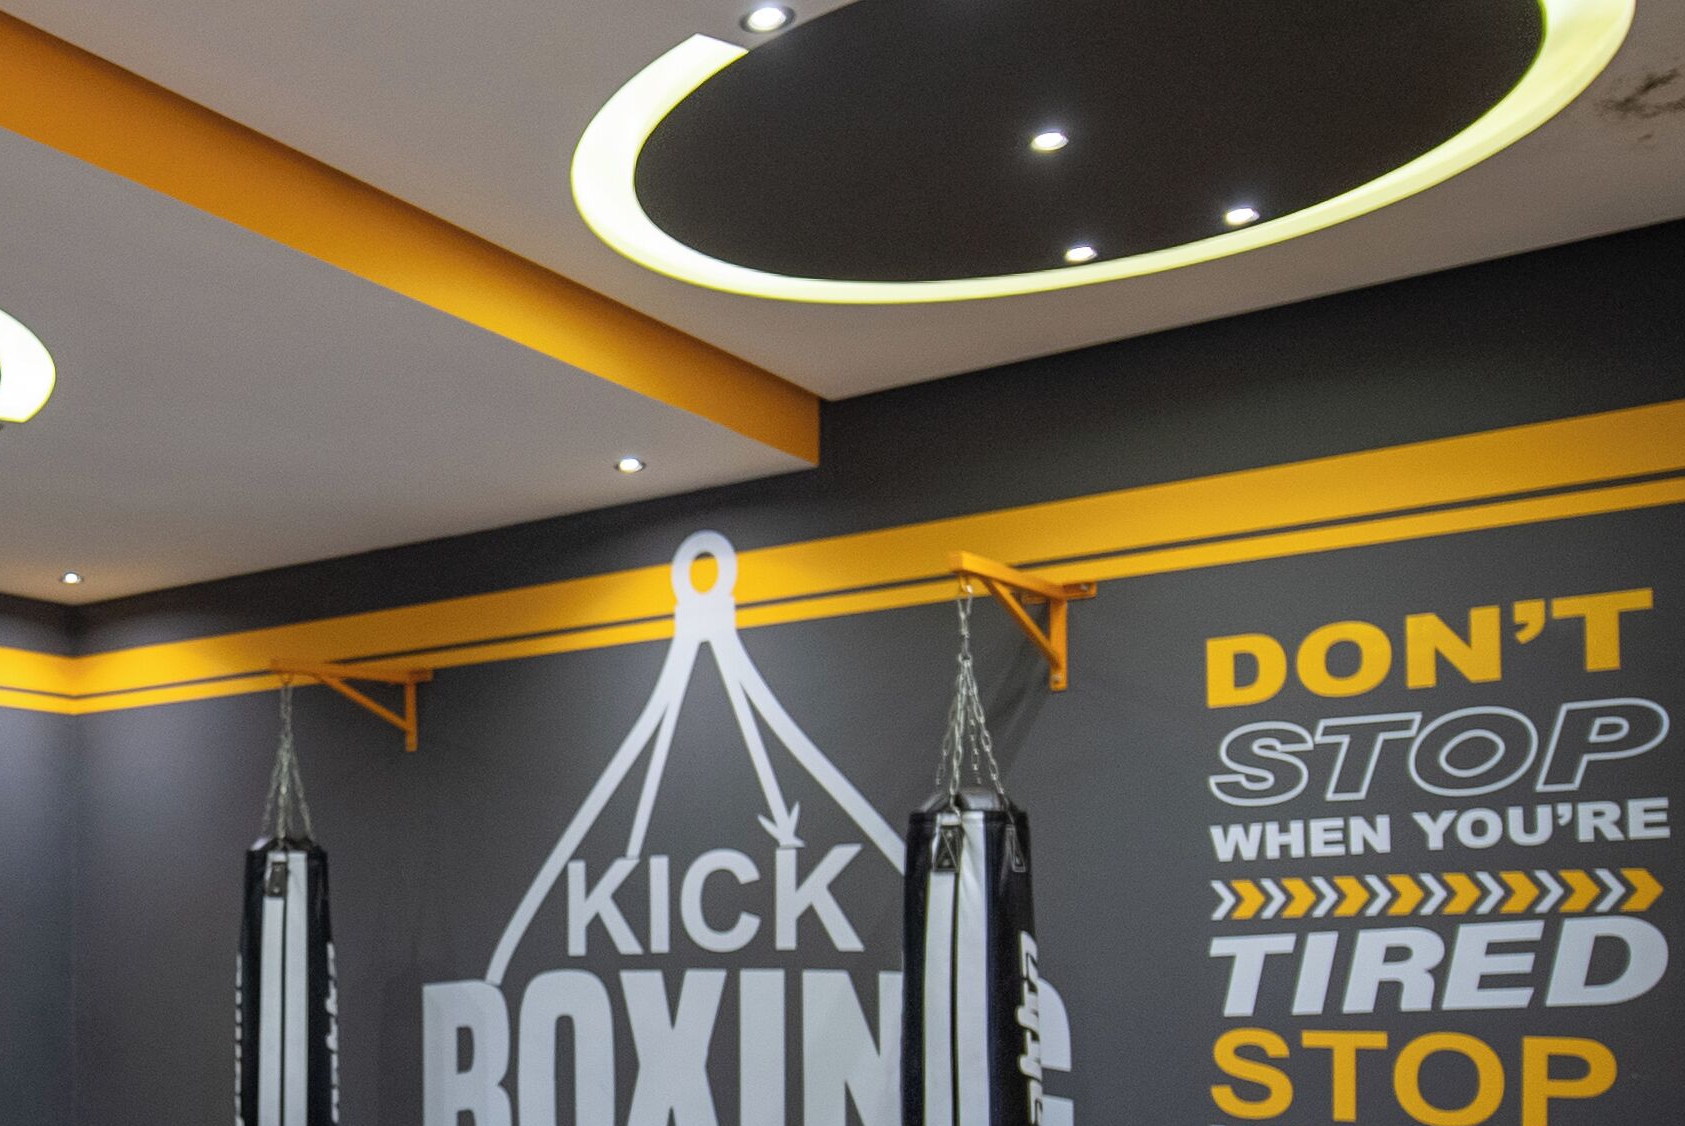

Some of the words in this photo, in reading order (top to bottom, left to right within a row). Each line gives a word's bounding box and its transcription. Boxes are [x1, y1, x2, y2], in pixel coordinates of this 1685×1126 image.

[1206, 588, 1654, 708] DON'T
[1208, 698, 1670, 807] STOP
[1210, 814, 1391, 862] WHEN
[1412, 797, 1671, 849] YOU'RE
[567, 843, 864, 956] KICK
[1209, 915, 1669, 1017] TIRED
